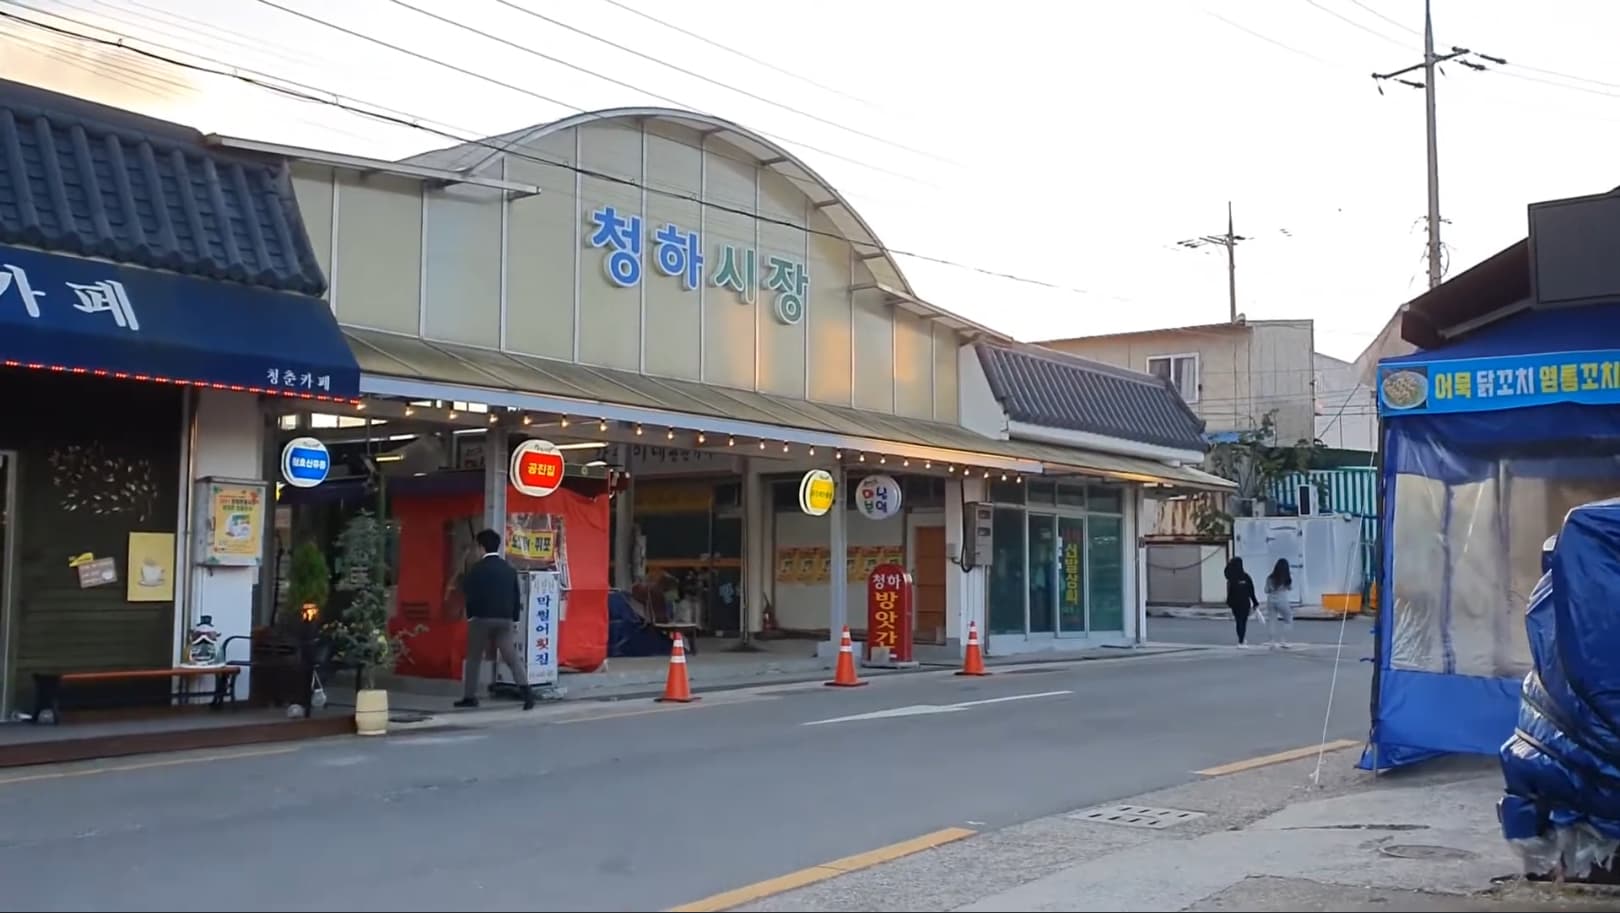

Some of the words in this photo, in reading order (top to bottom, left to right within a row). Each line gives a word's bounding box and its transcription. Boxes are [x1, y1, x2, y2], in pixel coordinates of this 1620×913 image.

[591, 205, 810, 325] 청하시장
[266, 368, 331, 393] 청춘카페
[1434, 372, 1472, 399] 어묵
[1477, 367, 1535, 398] 닭꼬치
[527, 462, 556, 477] 공진집
[872, 574, 901, 590] 청하
[874, 592, 899, 649] 방앗간
